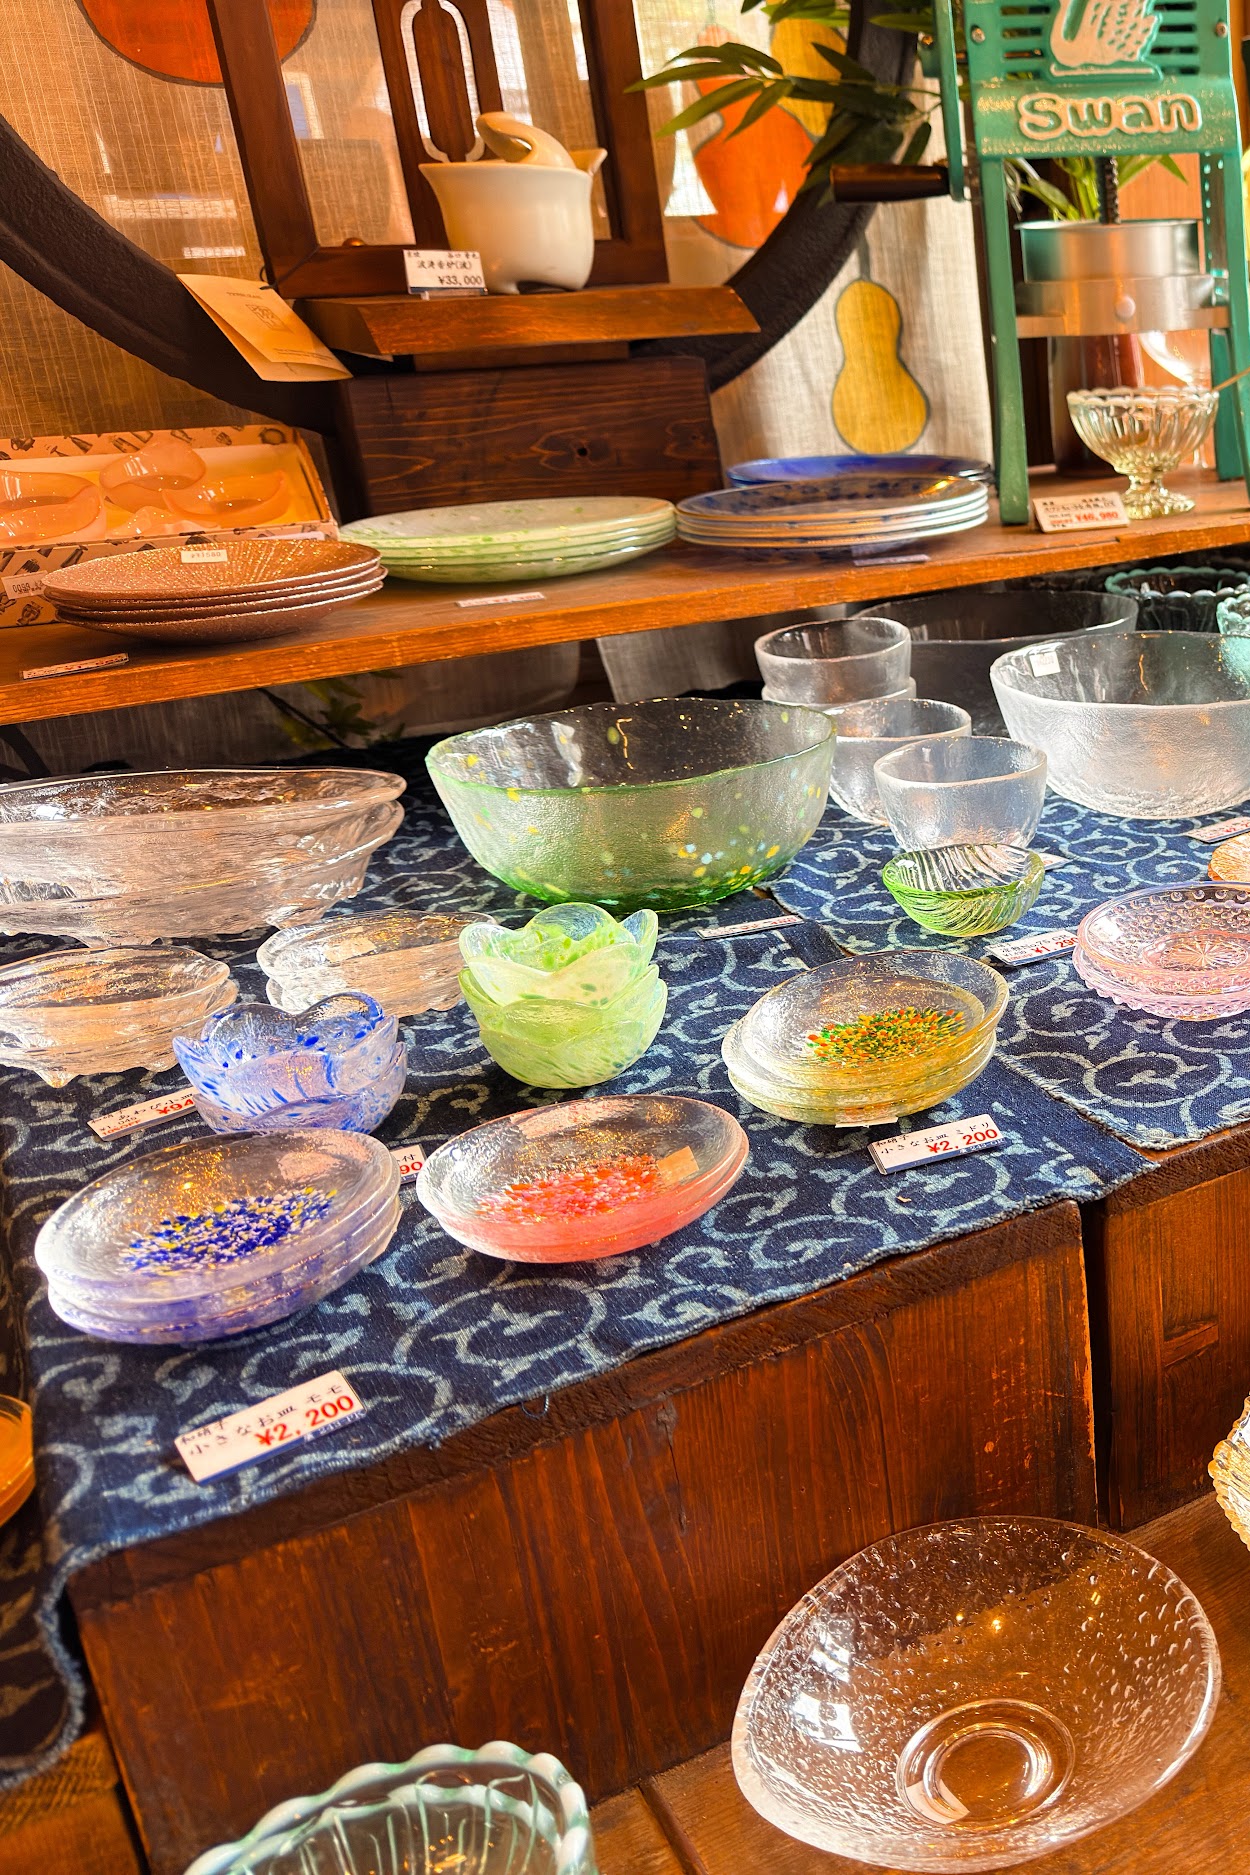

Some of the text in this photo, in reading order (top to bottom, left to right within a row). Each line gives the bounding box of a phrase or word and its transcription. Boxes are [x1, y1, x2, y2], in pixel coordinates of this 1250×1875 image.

[1018, 93, 1202, 140] Swan
[438, 275, 483, 286] ¥33,000
[156, 1099, 194, 1115] ¥94
[880, 1122, 989, 1154] 小さなお皿 ミドリ
[927, 1129, 998, 1153] ¥2,200
[180, 1418, 230, 1444] 和硝子
[189, 1385, 343, 1455] 小さなお皿 モモ
[255, 1395, 354, 1446] ¥2,200
